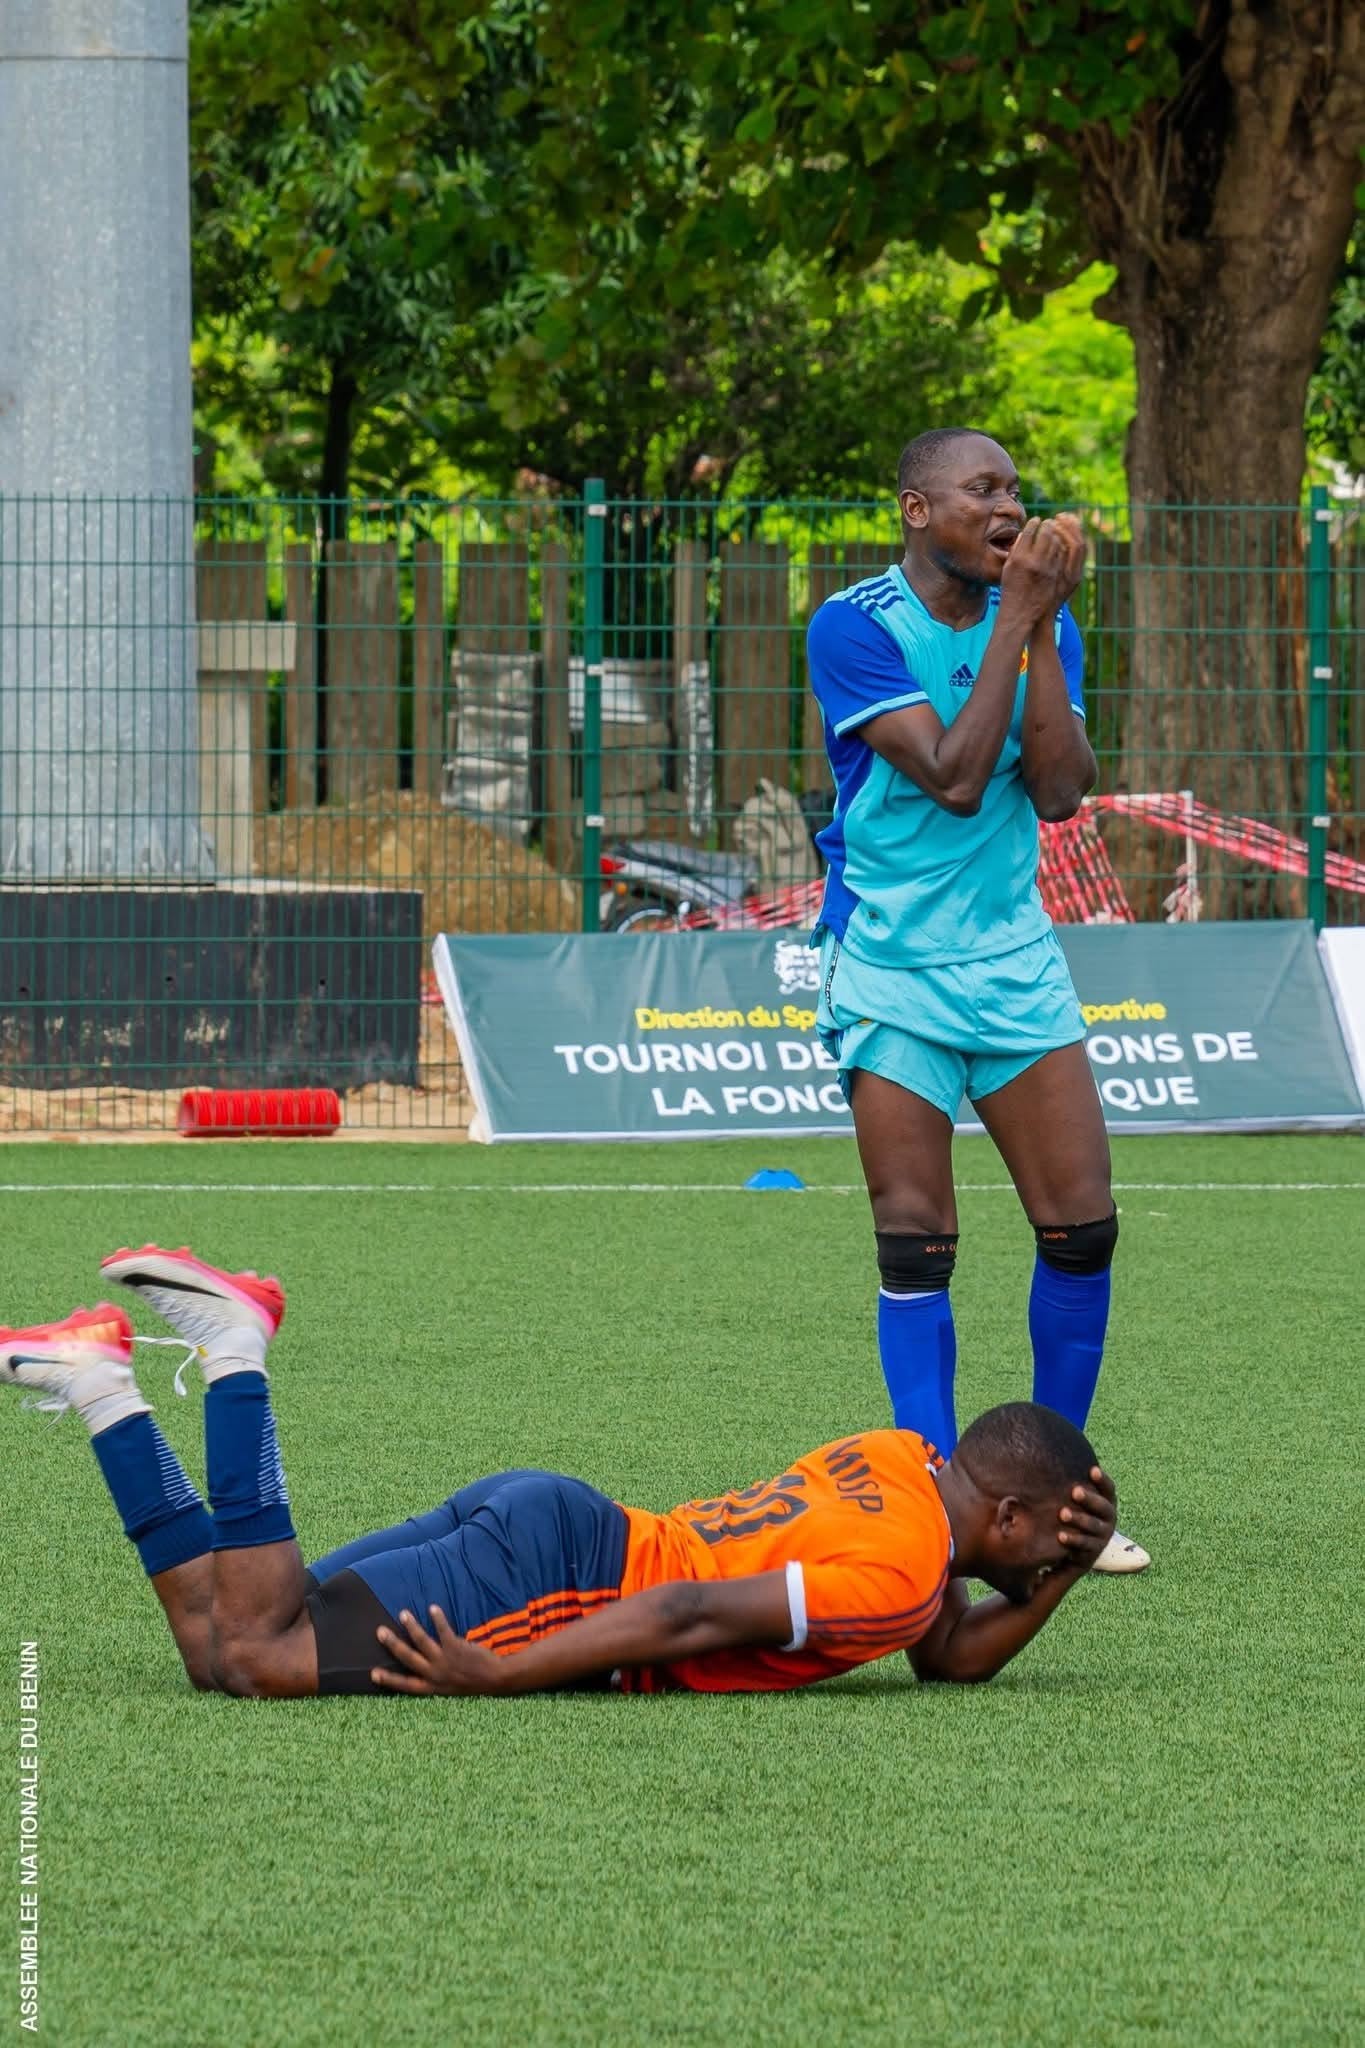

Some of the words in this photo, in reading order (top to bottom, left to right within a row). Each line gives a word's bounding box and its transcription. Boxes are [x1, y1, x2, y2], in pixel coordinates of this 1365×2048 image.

[949, 679, 976, 688] adida
[635, 1006, 746, 1030] Direction
[747, 1005, 781, 1028] du
[782, 1004, 817, 1032] Sp
[1081, 998, 1167, 1027] portive
[553, 1041, 768, 1074] TOURNOI
[776, 1041, 839, 1071] DE
[1086, 1033, 1184, 1066] ONS
[1192, 1031, 1260, 1063] DE
[651, 1086, 716, 1117] LA
[721, 1083, 852, 1115] FONC
[1097, 1076, 1200, 1112] QUE
